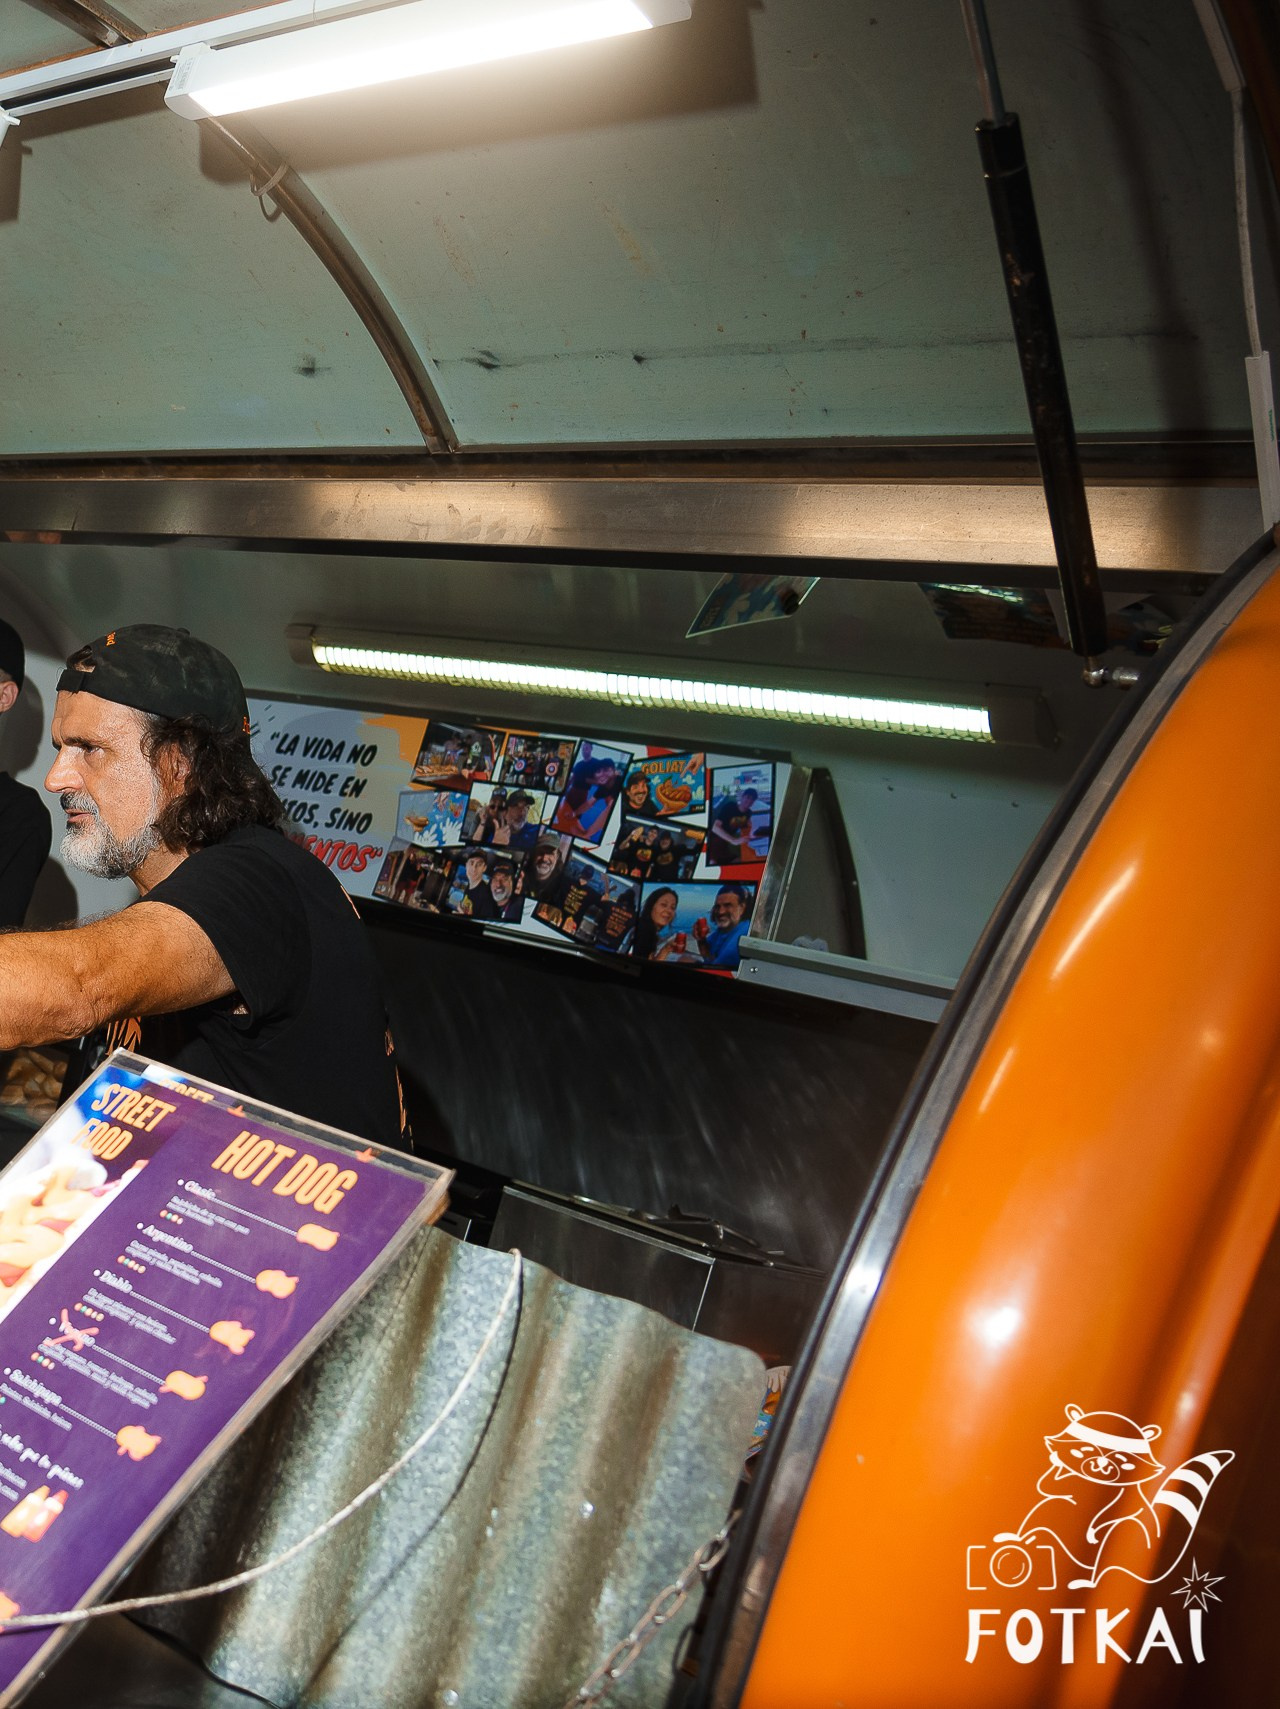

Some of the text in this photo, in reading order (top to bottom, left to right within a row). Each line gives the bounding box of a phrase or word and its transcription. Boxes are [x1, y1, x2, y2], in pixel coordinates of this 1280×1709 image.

[302, 736, 346, 762] VIDA
[346, 744, 378, 766] NO
[642, 760, 686, 774] GOLIAT
[271, 765, 368, 798] SE MIDE EN
[282, 799, 372, 834] TOS, SINO
[91, 1084, 177, 1132] STREET
[73, 1118, 134, 1160] FOOD
[211, 1130, 359, 1215] HOT DOG
[142, 1225, 193, 1253] Argentino
[99, 1270, 132, 1293] Diablo
[9, 1369, 61, 1405] Salchipapa
